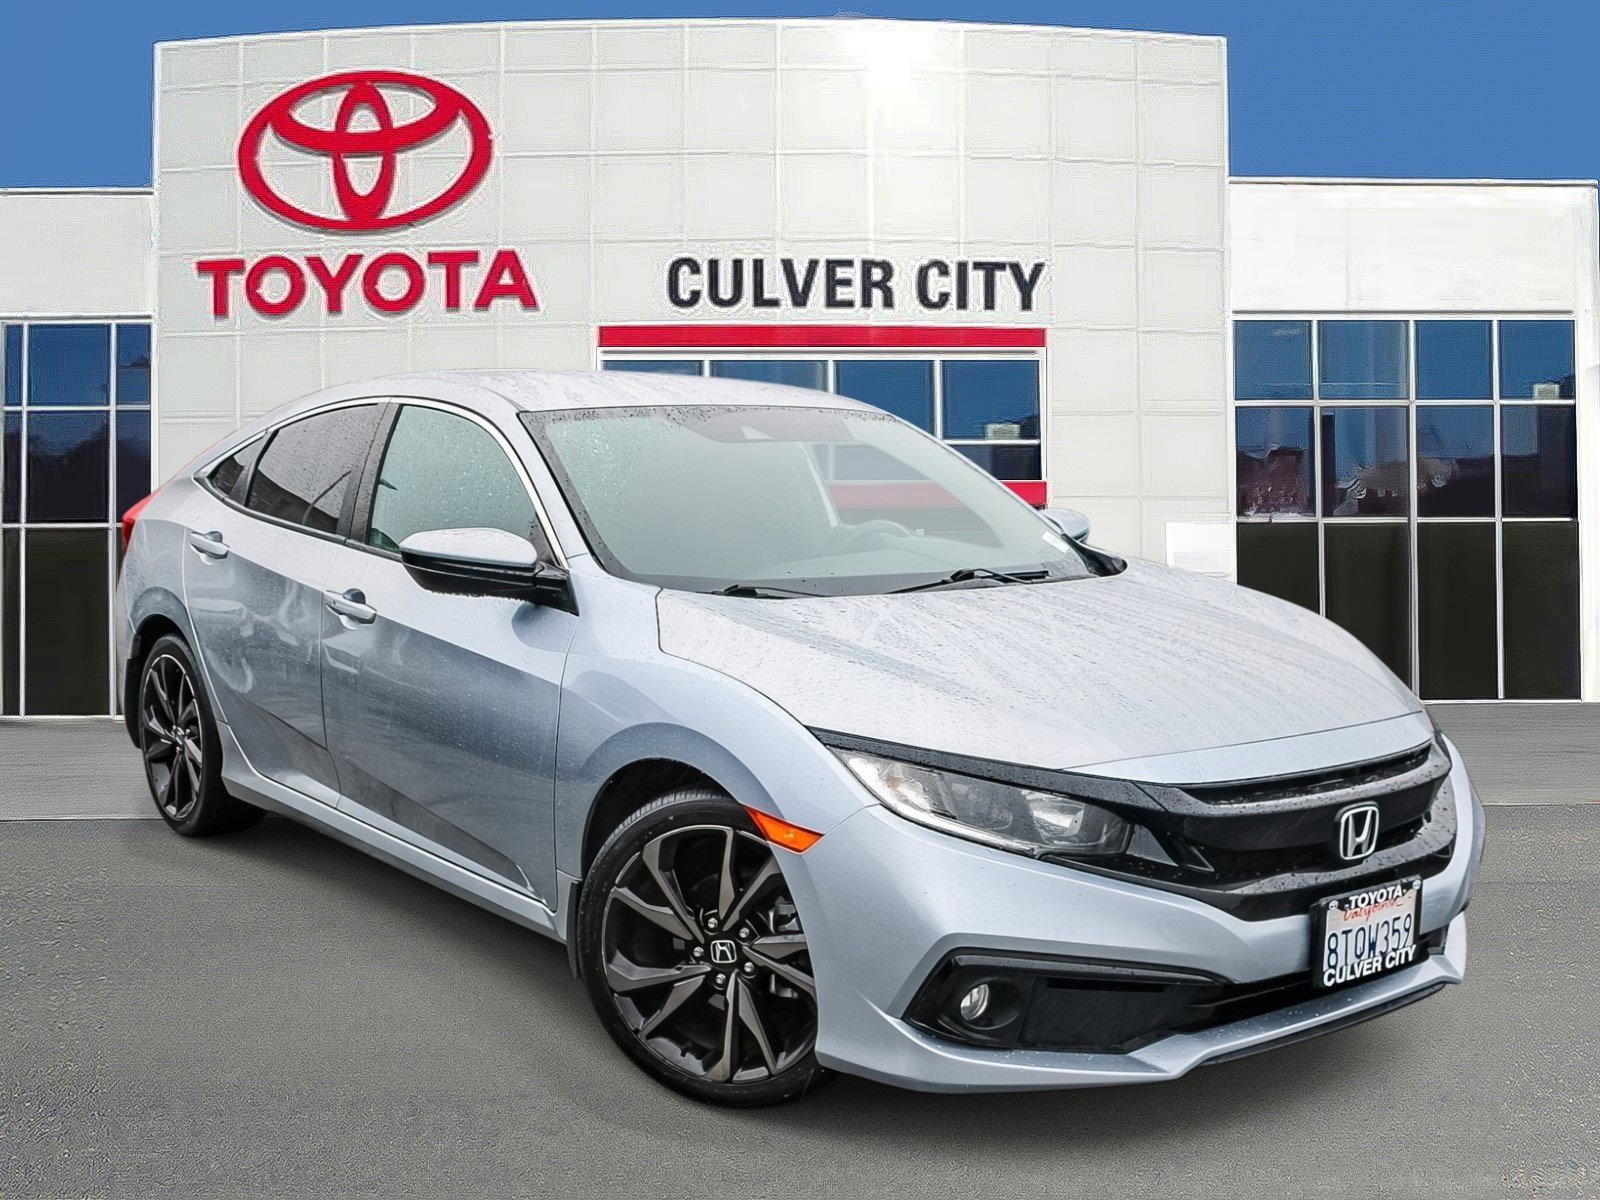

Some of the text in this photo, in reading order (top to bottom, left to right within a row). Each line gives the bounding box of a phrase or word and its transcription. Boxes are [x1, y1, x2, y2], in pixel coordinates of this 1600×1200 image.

[196, 250, 540, 318] TOYOTA
[667, 256, 1045, 311] CULVER CITY
[1349, 885, 1402, 909] TOYOTA
[1323, 944, 1417, 987] CULVER CITY
